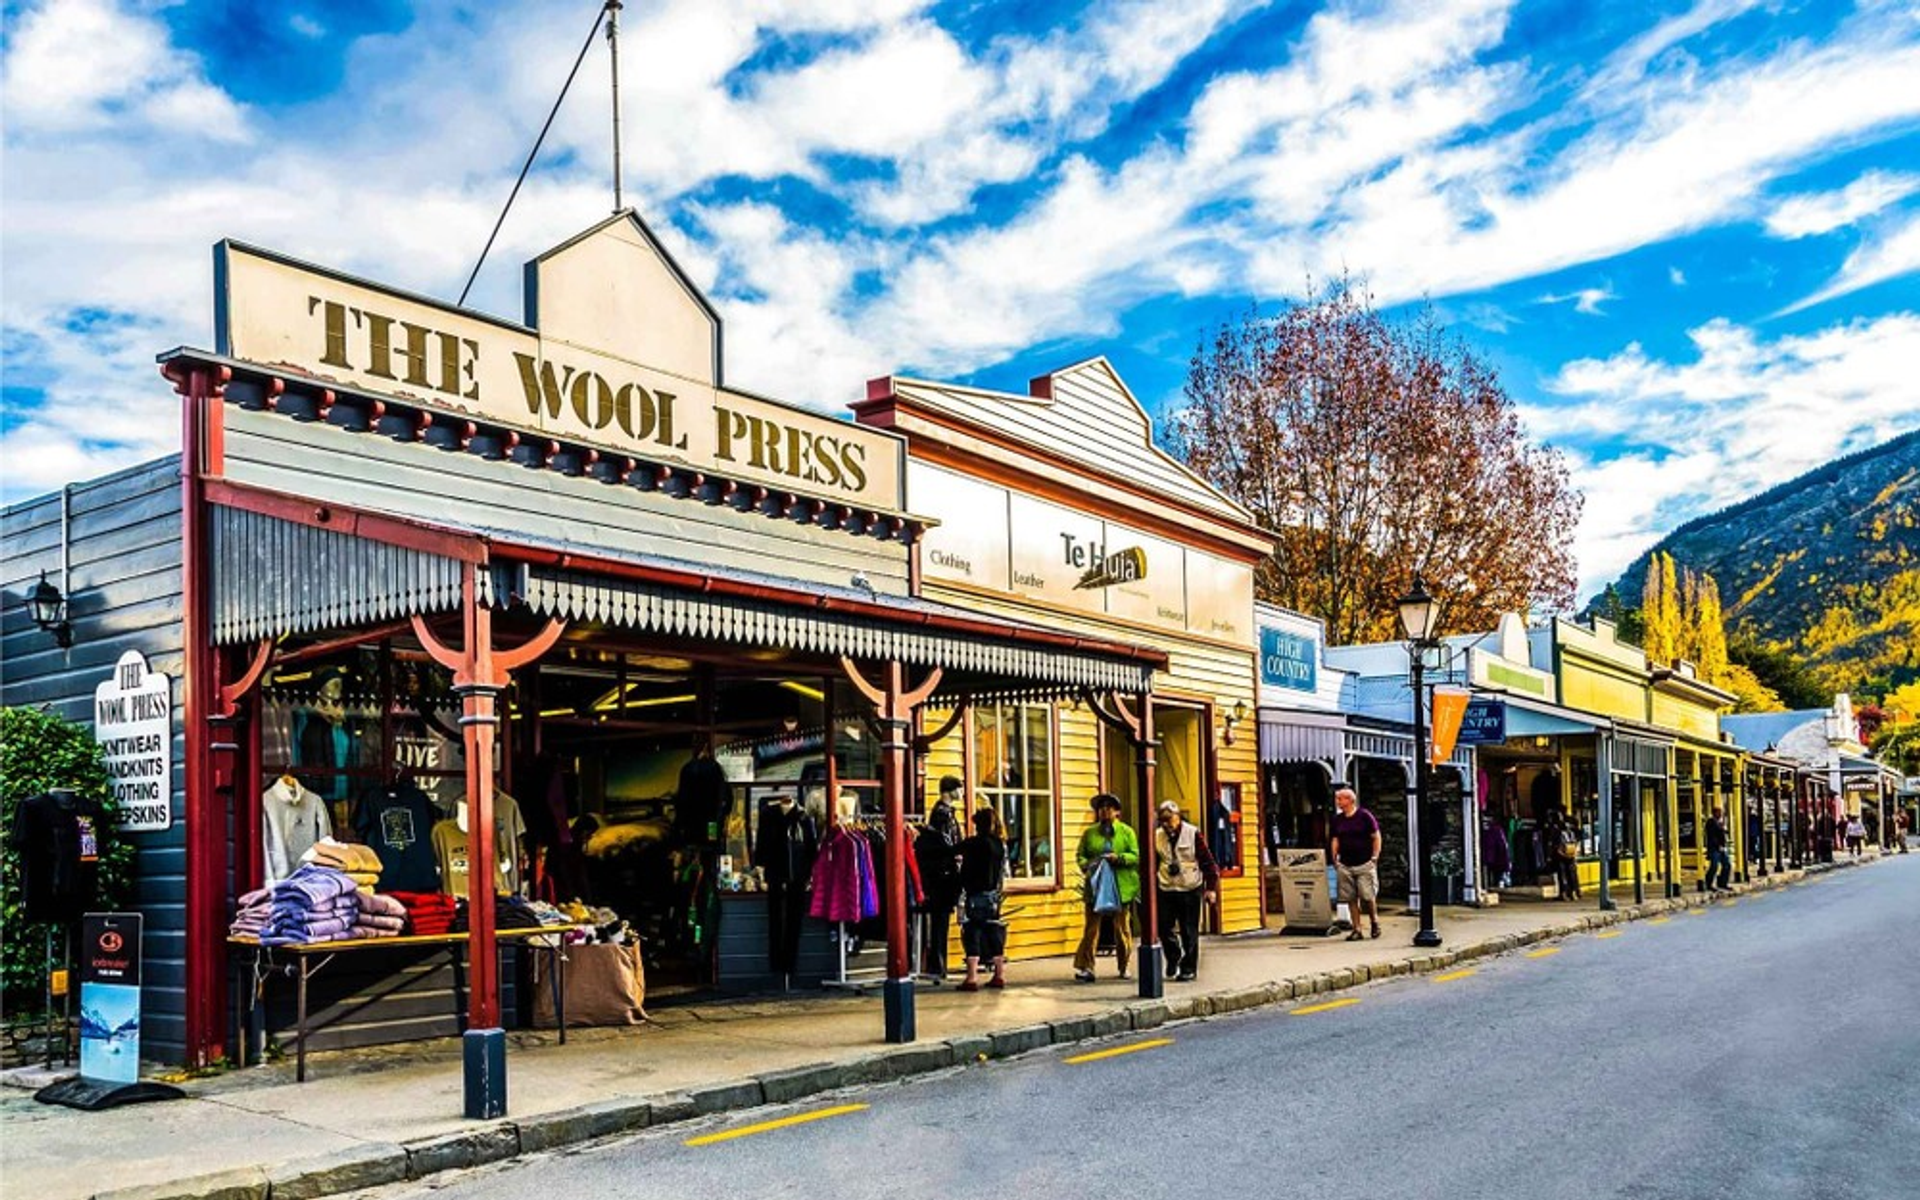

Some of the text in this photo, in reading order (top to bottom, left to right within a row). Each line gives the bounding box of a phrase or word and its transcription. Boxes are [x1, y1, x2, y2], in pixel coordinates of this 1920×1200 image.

[308, 295, 867, 493] THE WOOL PRESS
[928, 549, 972, 576] Clothing
[1060, 532, 1135, 580] Te Huia
[1013, 570, 1045, 589] Leather
[1276, 635, 1303, 660] HIGH
[119, 662, 142, 691] THE
[1266, 655, 1313, 681] COUNTRY
[98, 691, 167, 725] WOOL PRESS
[102, 734, 161, 757] KNITWEAR
[395, 743, 440, 768] LIVE
[106, 756, 163, 779] ANDKNITS
[109, 781, 159, 801] LOTHING
